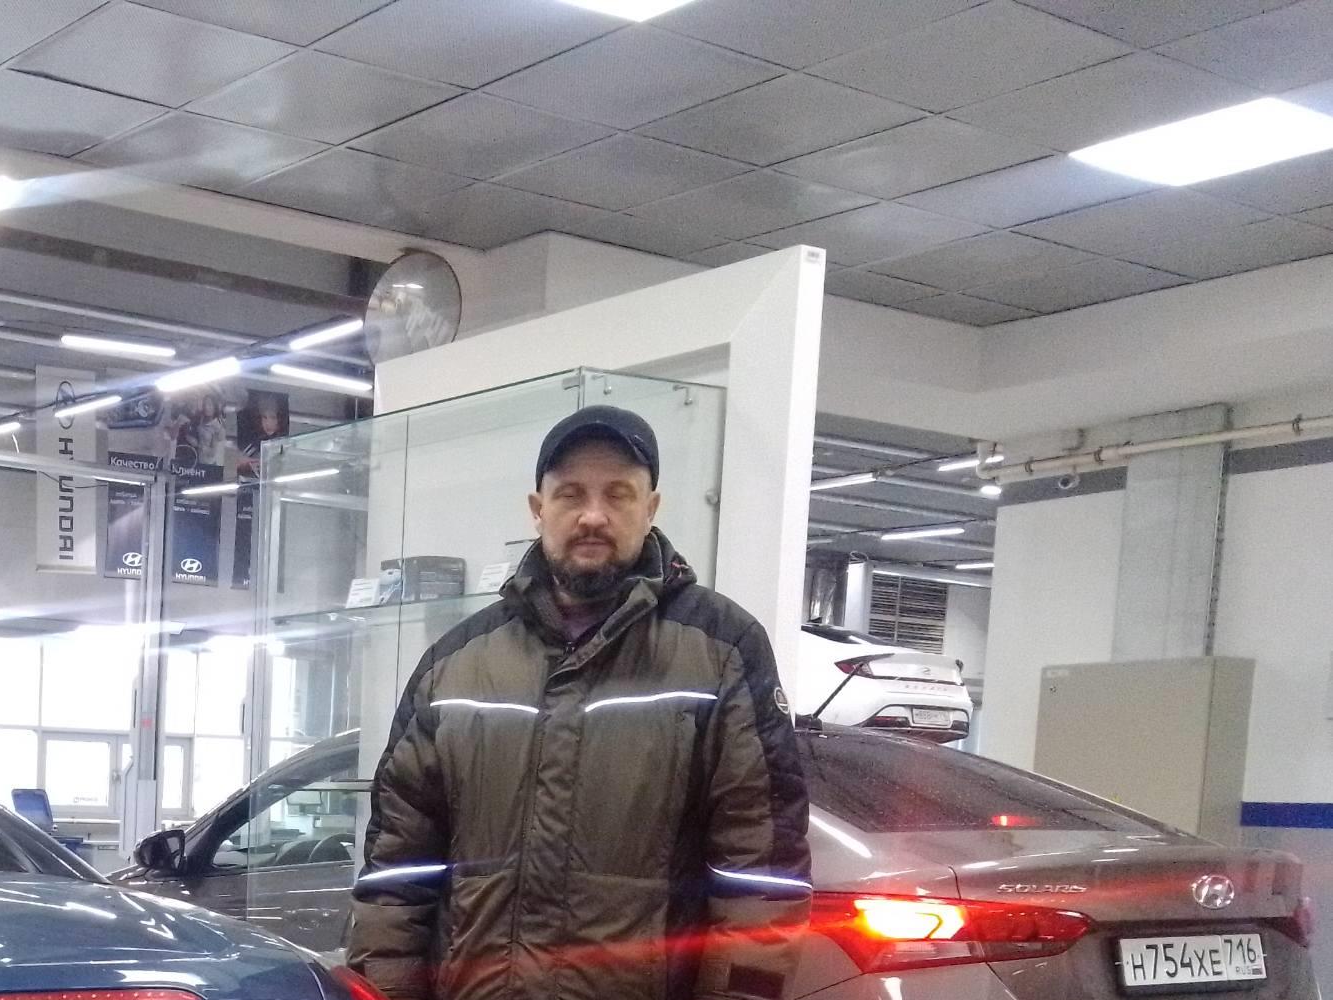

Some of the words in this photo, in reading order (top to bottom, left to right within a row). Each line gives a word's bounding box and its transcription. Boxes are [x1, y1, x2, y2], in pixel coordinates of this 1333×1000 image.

[110, 456, 155, 470] Качество
[58, 437, 74, 561] HUNDAI
[117, 567, 142, 575] HYUND
[1131, 942, 1223, 981] Н754ХЕ
[1223, 938, 1257, 966] 716
